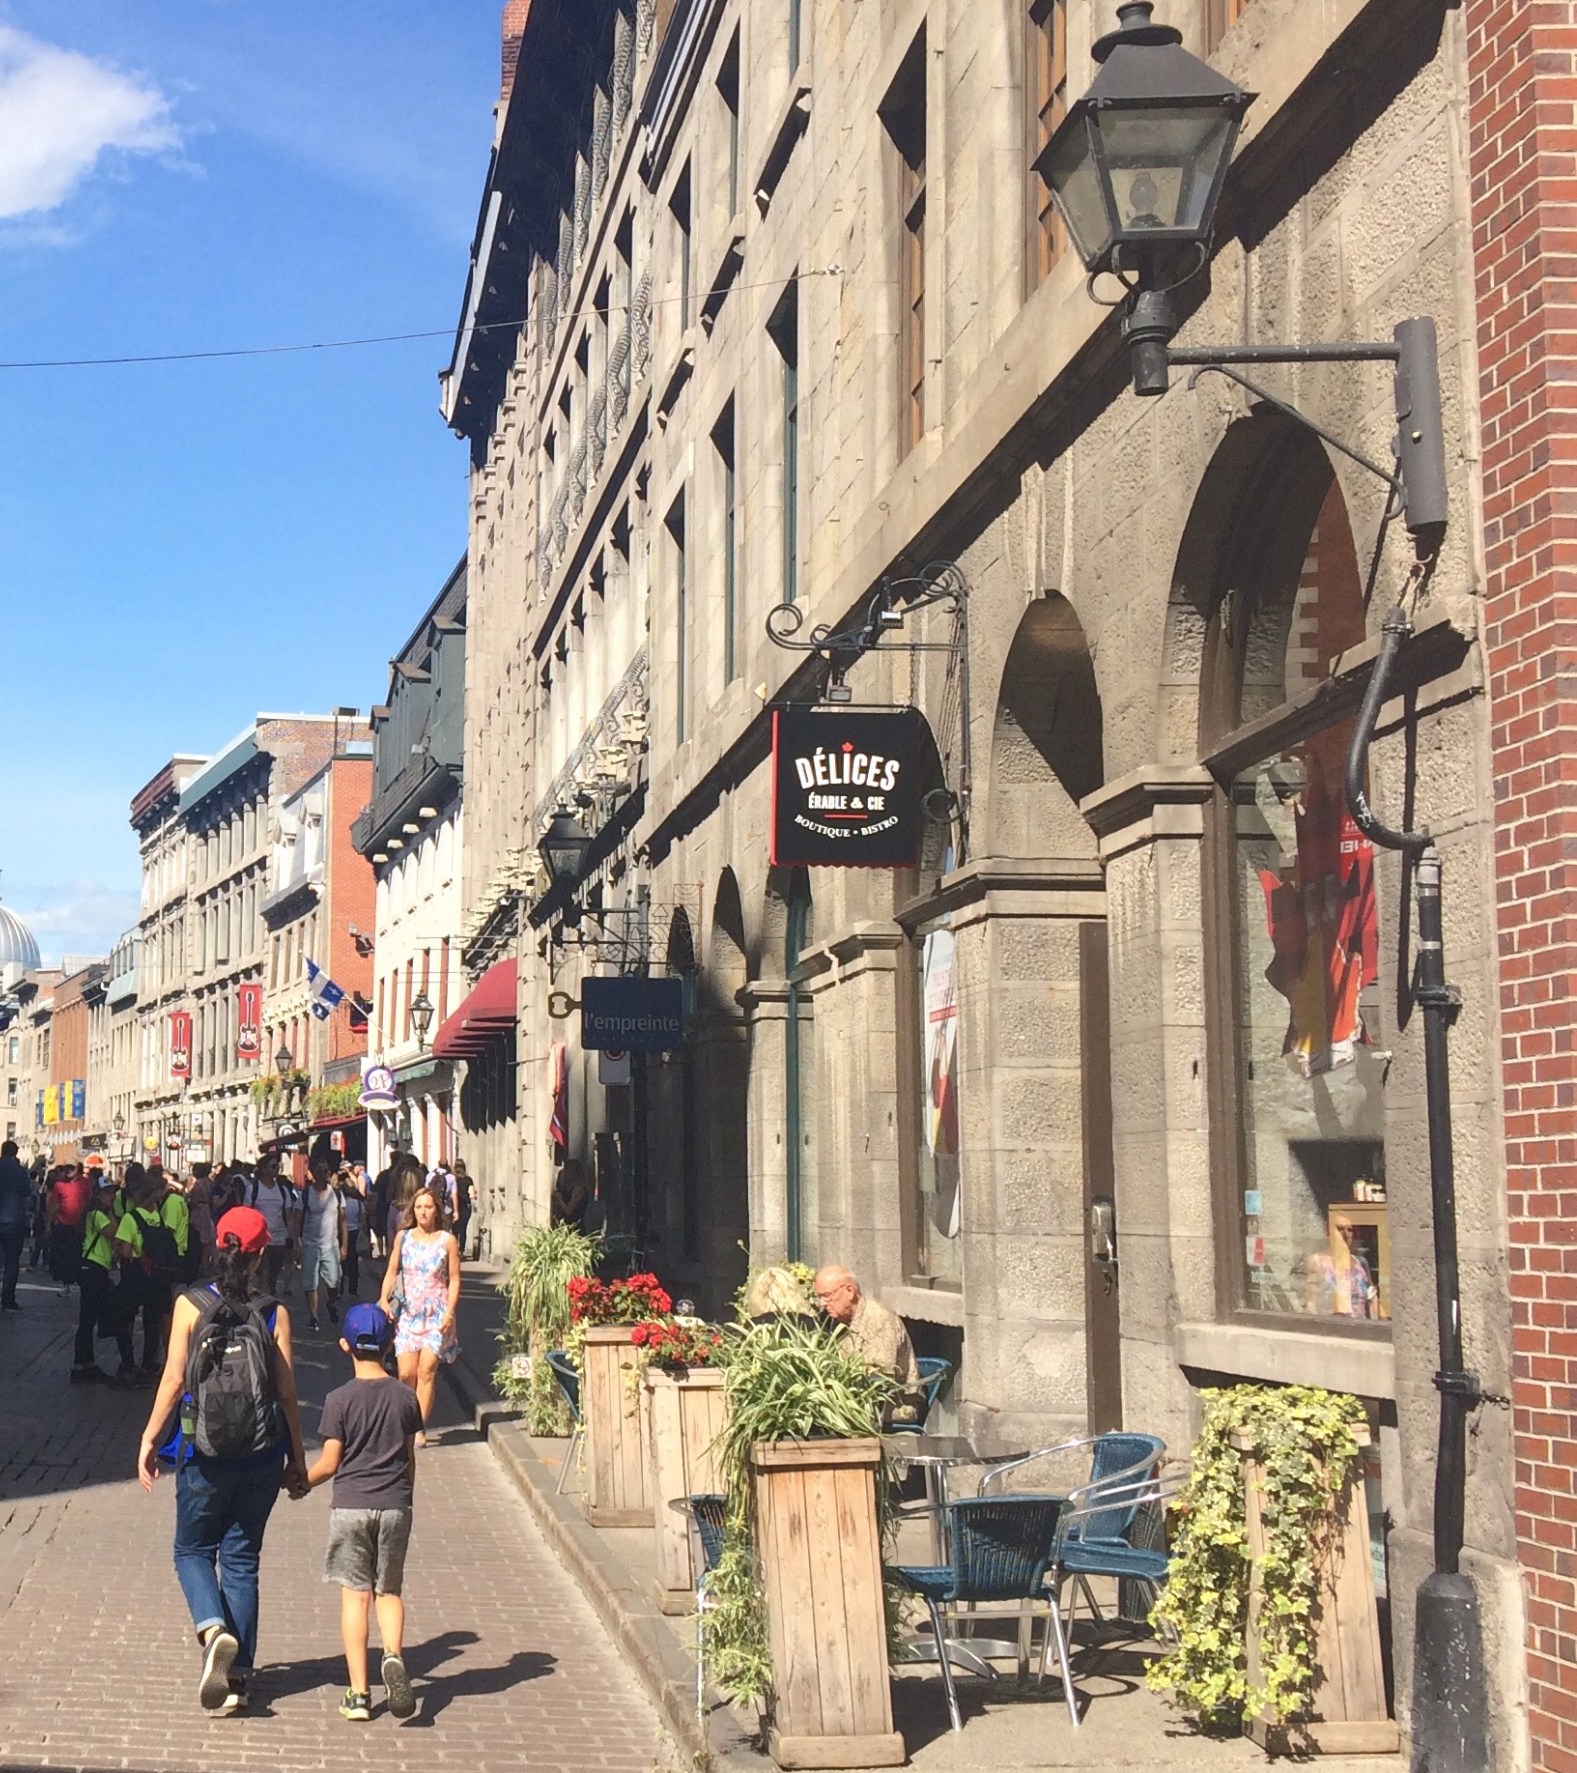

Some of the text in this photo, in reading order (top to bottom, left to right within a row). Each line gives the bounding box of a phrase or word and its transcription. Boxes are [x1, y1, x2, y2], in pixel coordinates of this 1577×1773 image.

[795, 747, 900, 791] DÉLICES
[808, 792, 885, 810] ÉRABLE & CIE
[794, 814, 899, 838] BOUTIQUE BISTRO
[584, 1012, 680, 1034] l'empreinte
